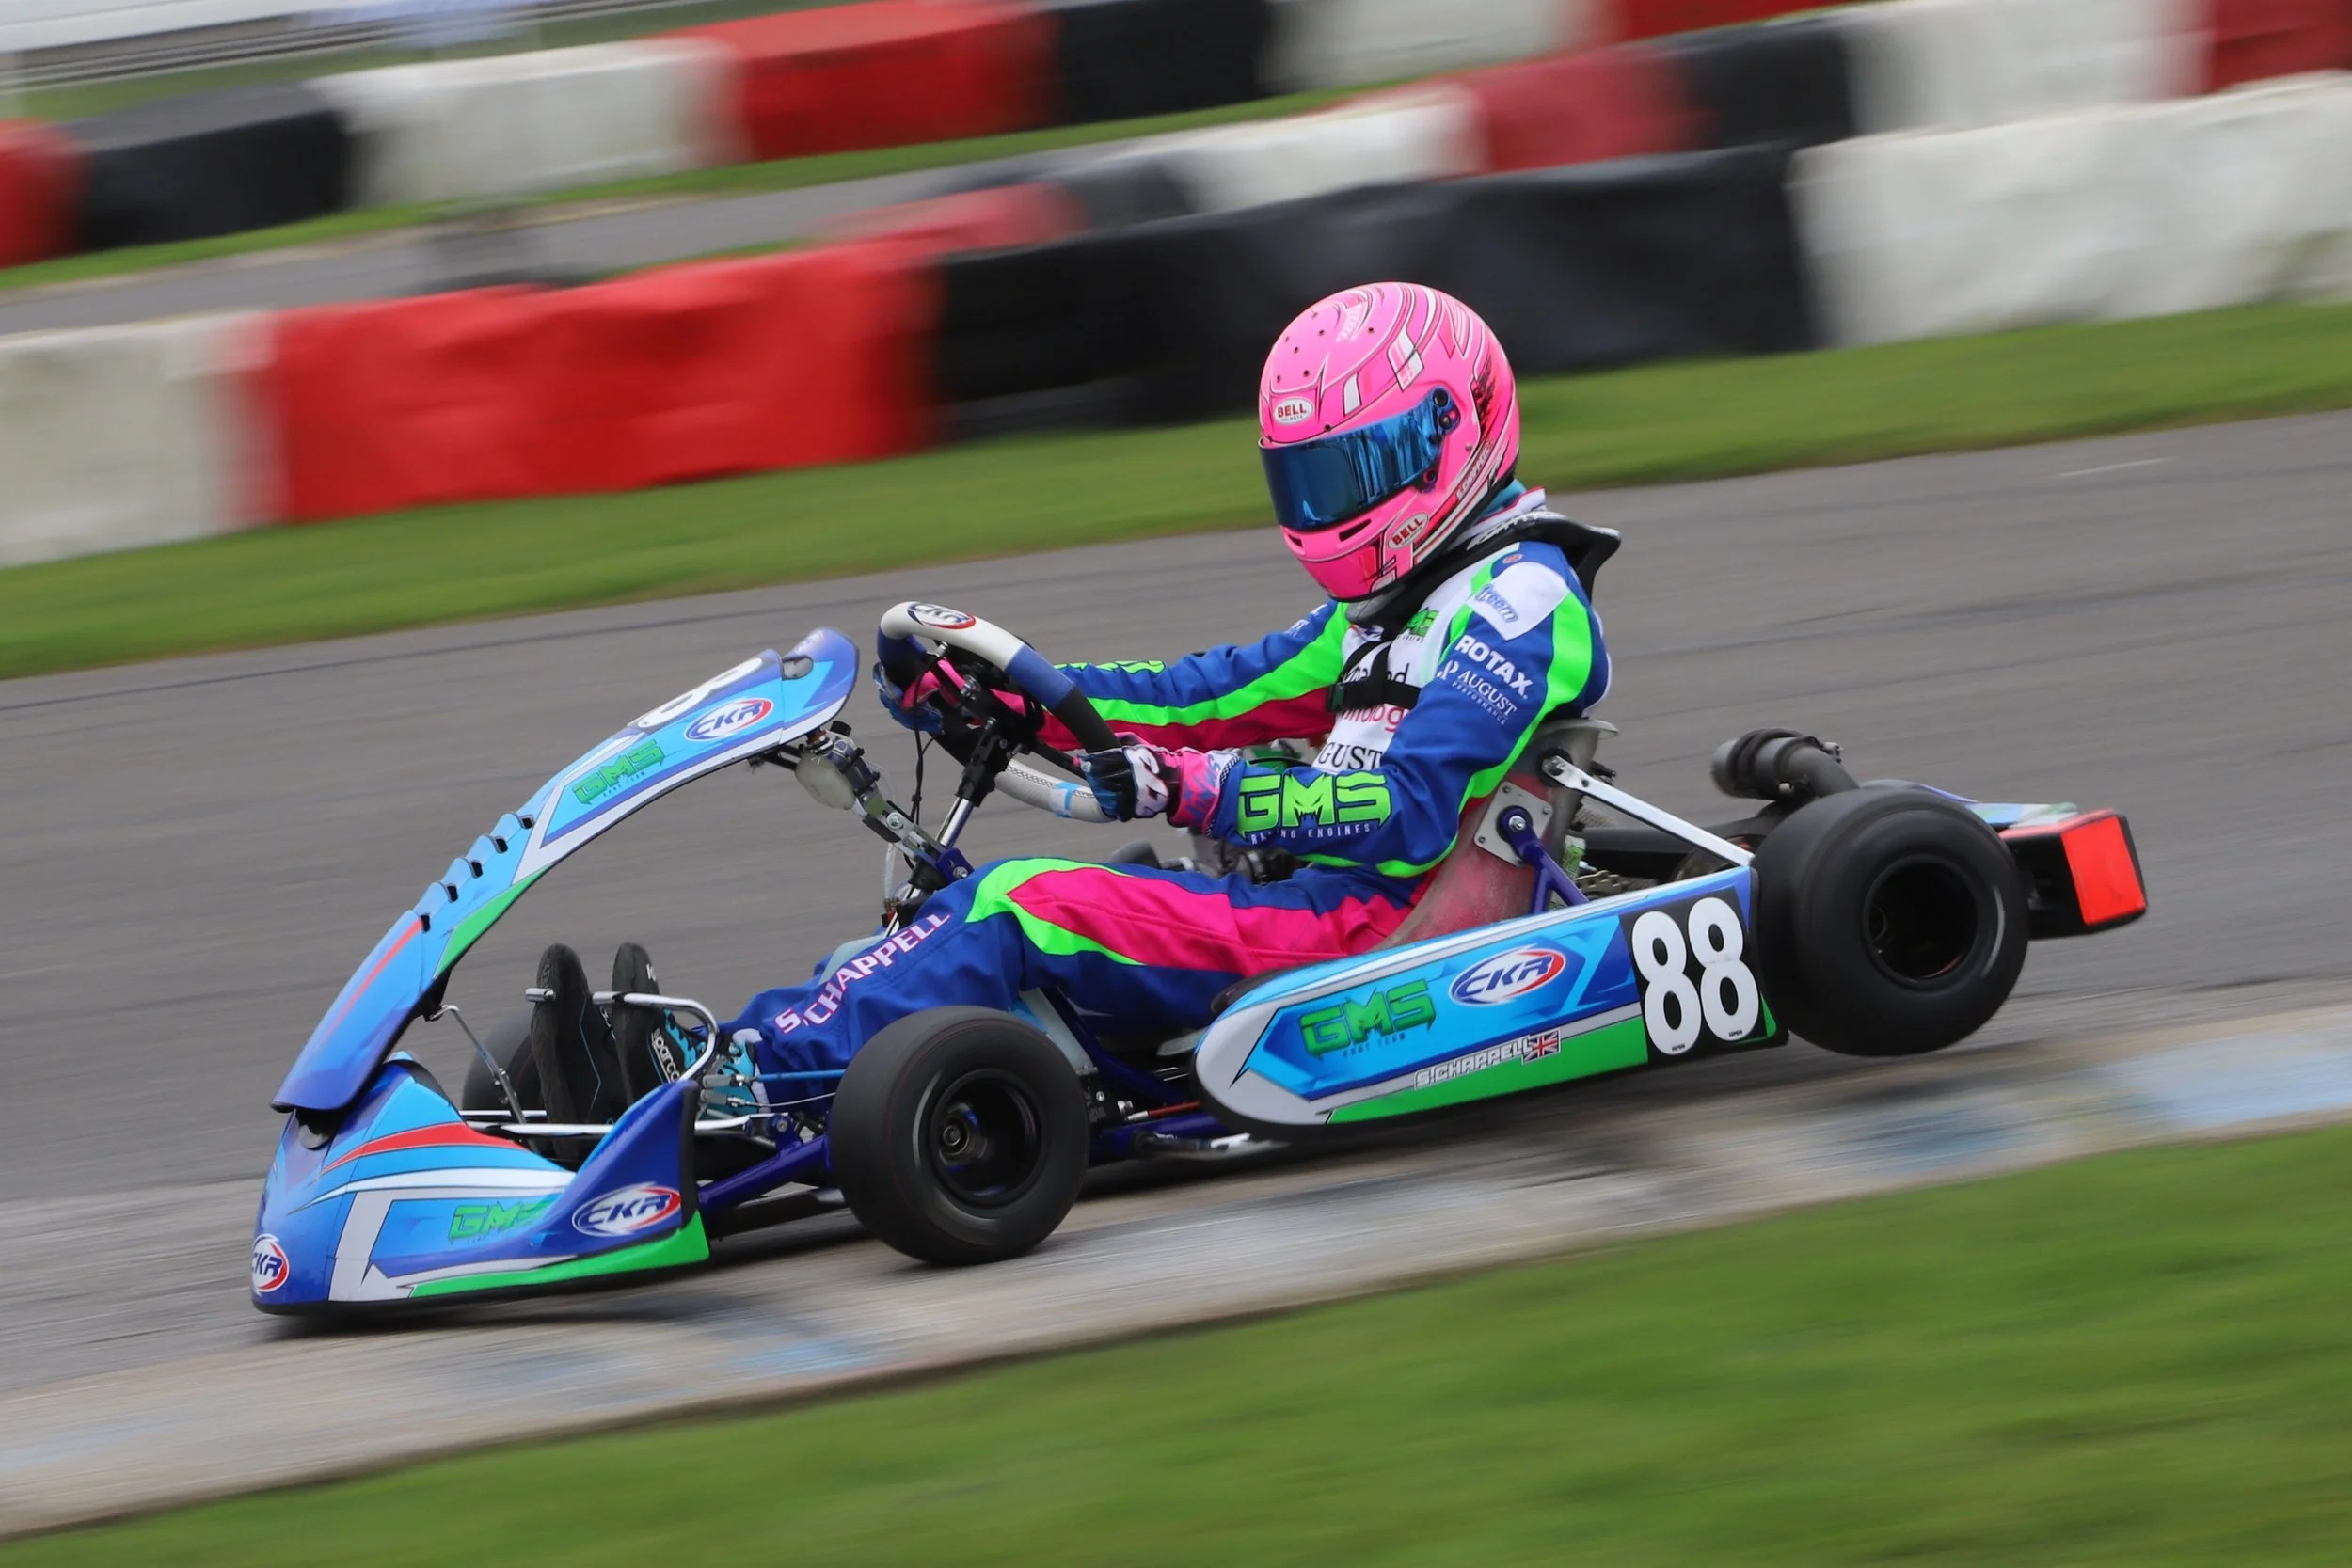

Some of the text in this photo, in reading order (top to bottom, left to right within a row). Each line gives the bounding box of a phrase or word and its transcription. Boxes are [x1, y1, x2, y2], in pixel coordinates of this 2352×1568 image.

[1278, 403, 1307, 418] BELL
[1392, 518, 1423, 546] BELL
[1454, 635, 1533, 696] ROTAX
[694, 700, 764, 733] CKR
[1452, 681, 1507, 726] PERFORMANCE
[1458, 670, 1517, 717] AUGUST
[572, 739, 664, 805] GMS
[1236, 770, 1392, 840] GMS
[1308, 823, 1371, 839] ENGINES
[1456, 954, 1554, 999] CKR
[1631, 896, 1759, 1056] 88
[1298, 978, 1437, 1061] GMS
[1414, 1034, 1535, 1090] S.CHAPPELL
